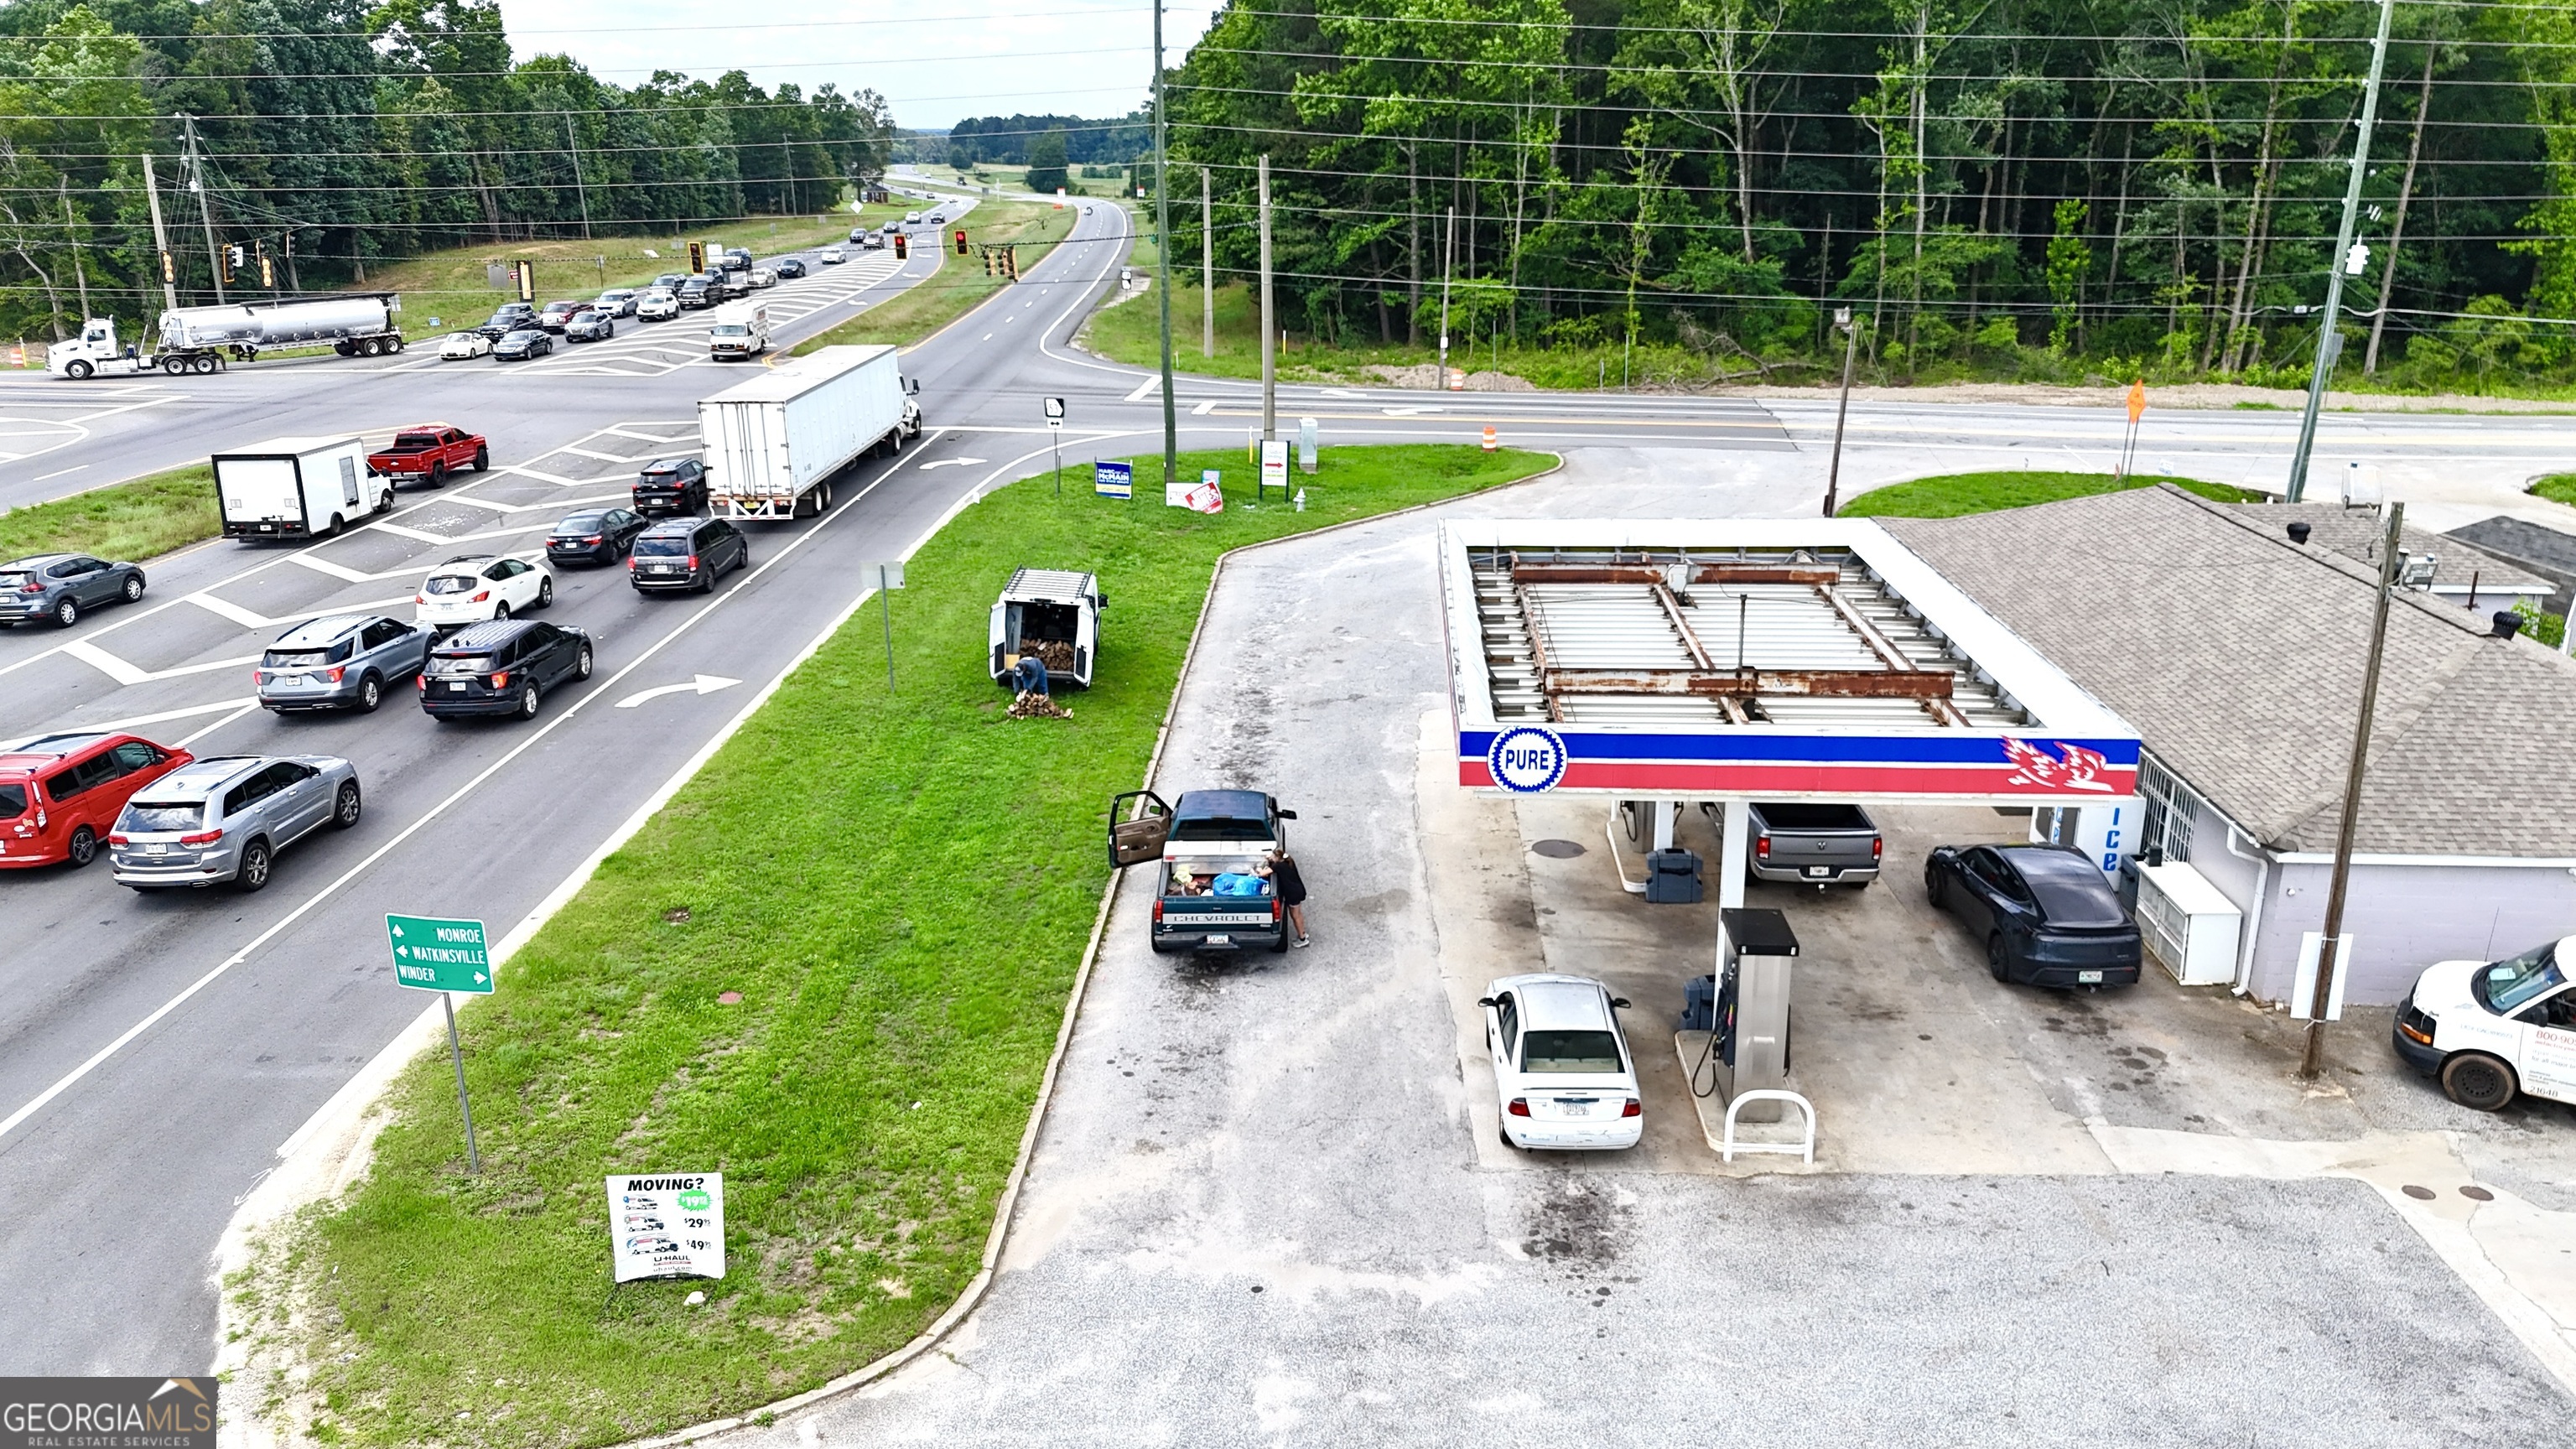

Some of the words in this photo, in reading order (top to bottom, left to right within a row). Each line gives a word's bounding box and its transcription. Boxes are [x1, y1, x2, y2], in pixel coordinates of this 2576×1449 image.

[1049, 403, 1059, 413] 53
[1505, 749, 1550, 770] PURE
[436, 927, 482, 943] MONROE
[411, 945, 486, 964] WATKINSVILLE
[397, 964, 436, 982] WINDER
[2529, 1085, 2558, 1098] 21648
[627, 1177, 704, 1192] MOVING?
